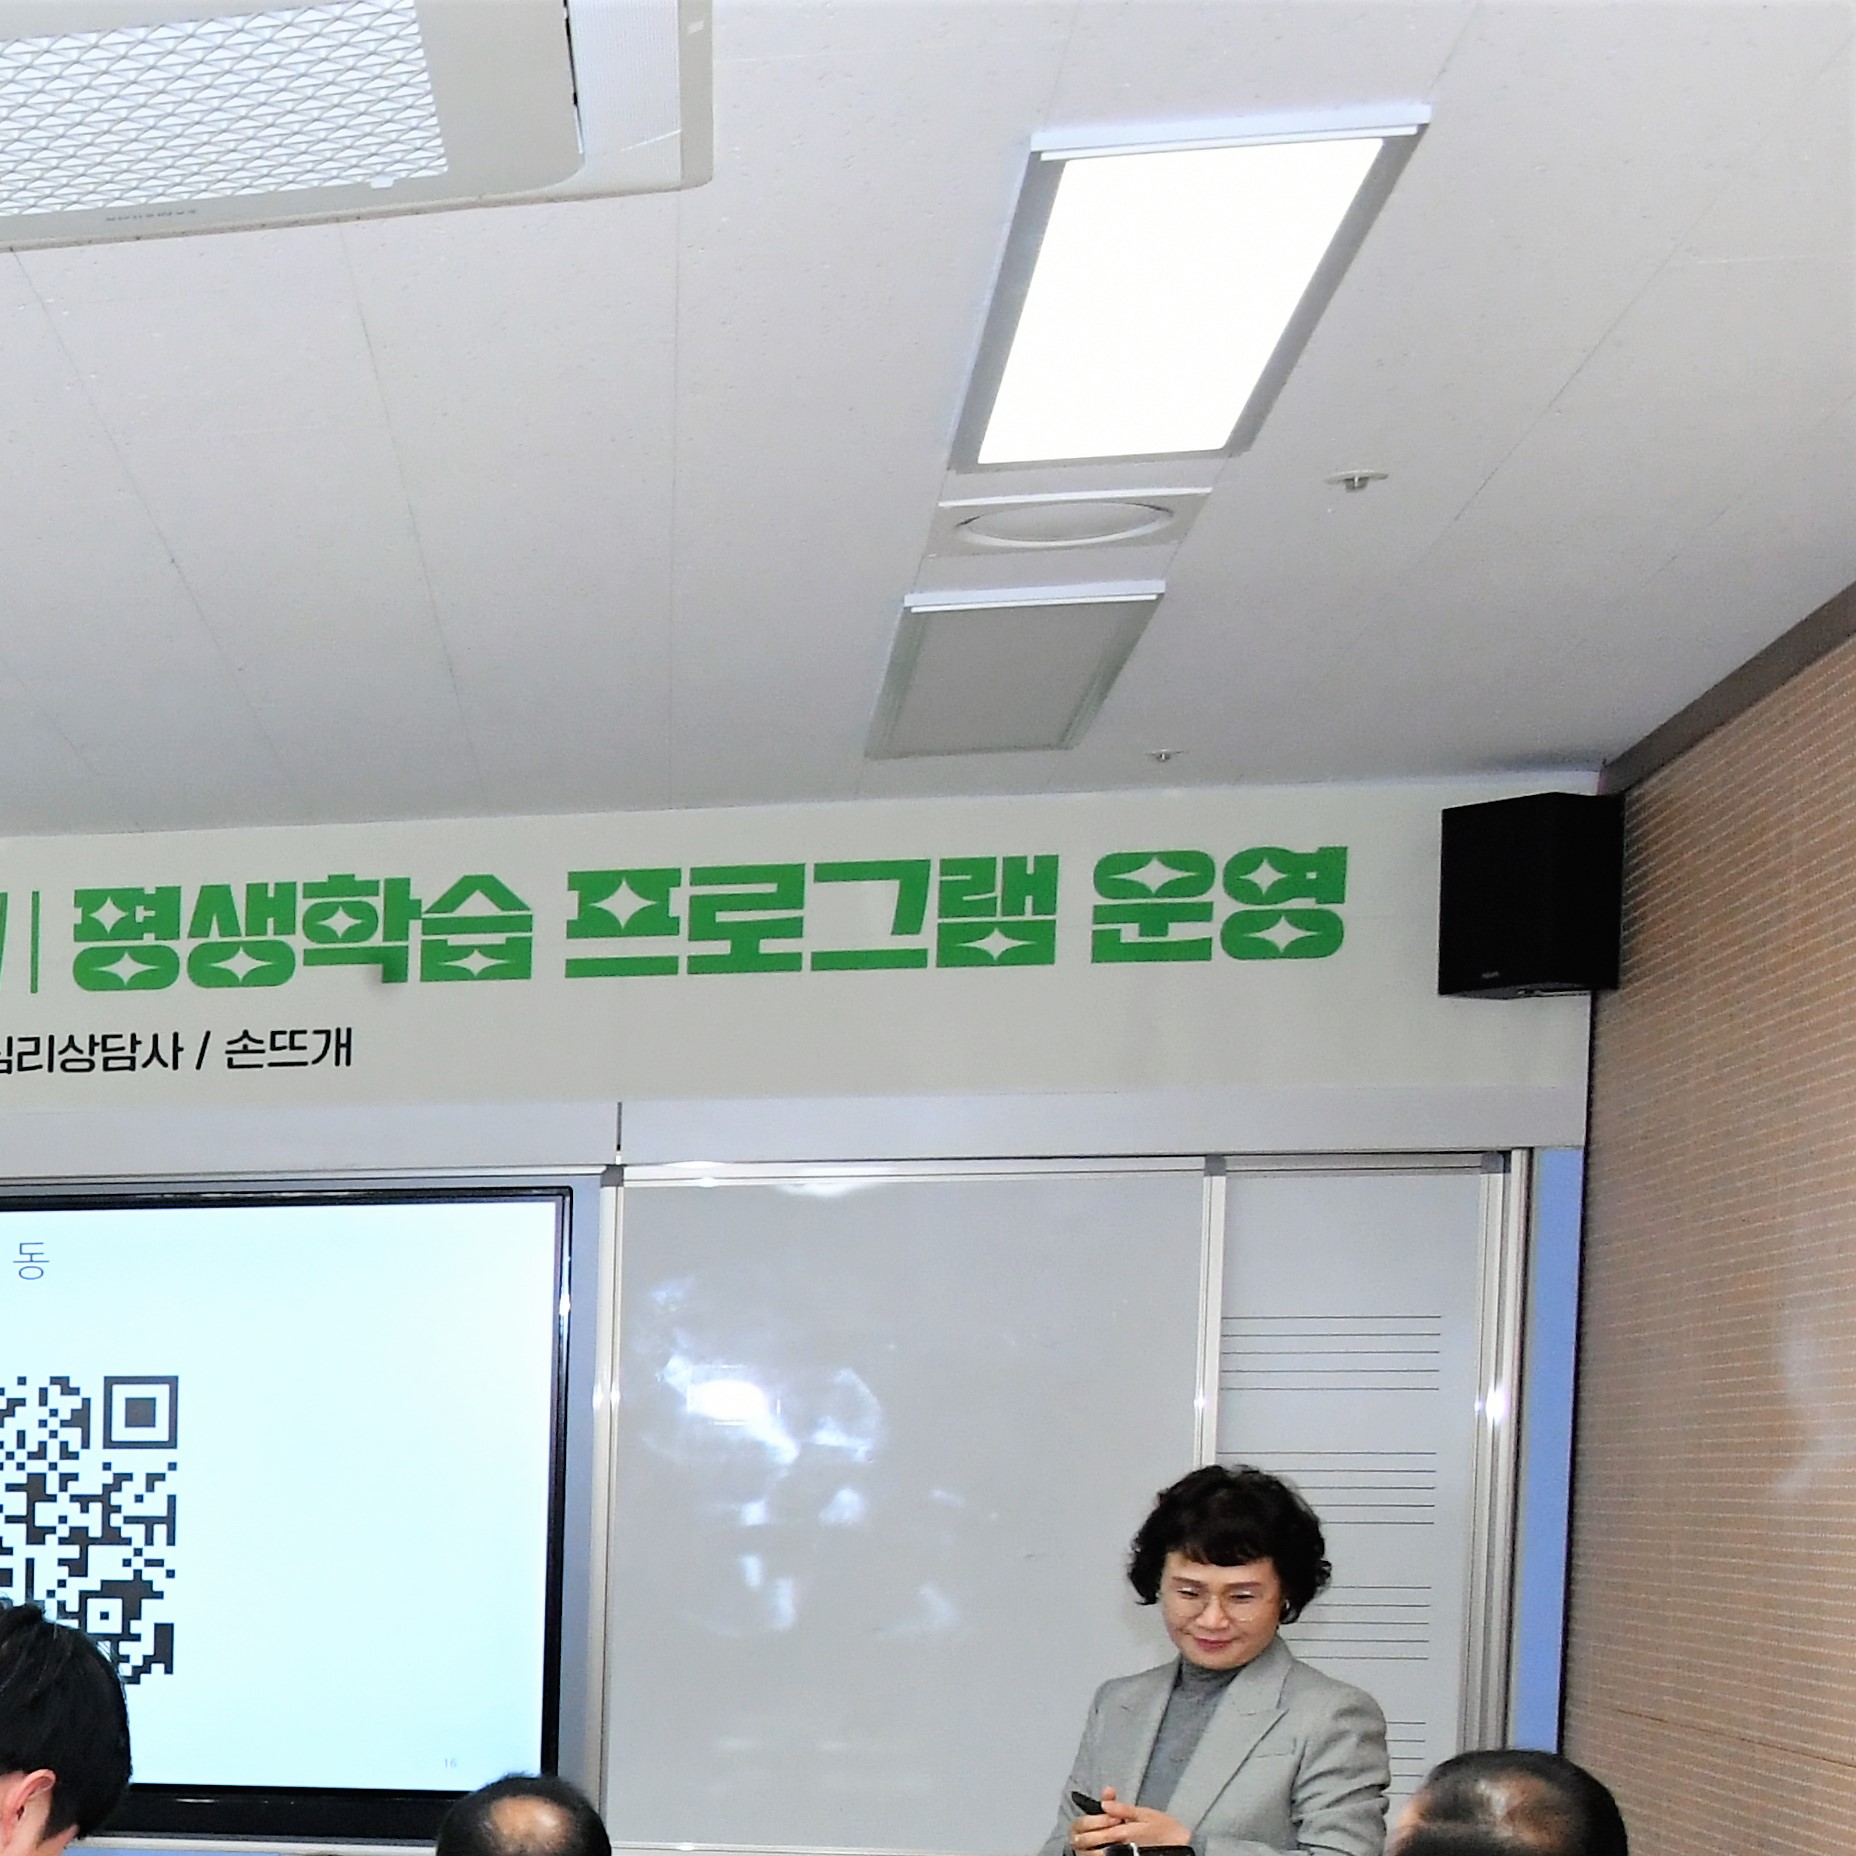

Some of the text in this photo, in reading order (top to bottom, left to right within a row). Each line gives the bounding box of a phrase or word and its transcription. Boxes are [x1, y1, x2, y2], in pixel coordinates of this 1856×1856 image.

[73, 873, 535, 992] 평생학습
[566, 855, 1060, 979] 프로그램
[1092, 846, 1349, 962] 운영
[196, 1031, 212, 1071] /
[224, 1027, 353, 1070] 손뜨개
